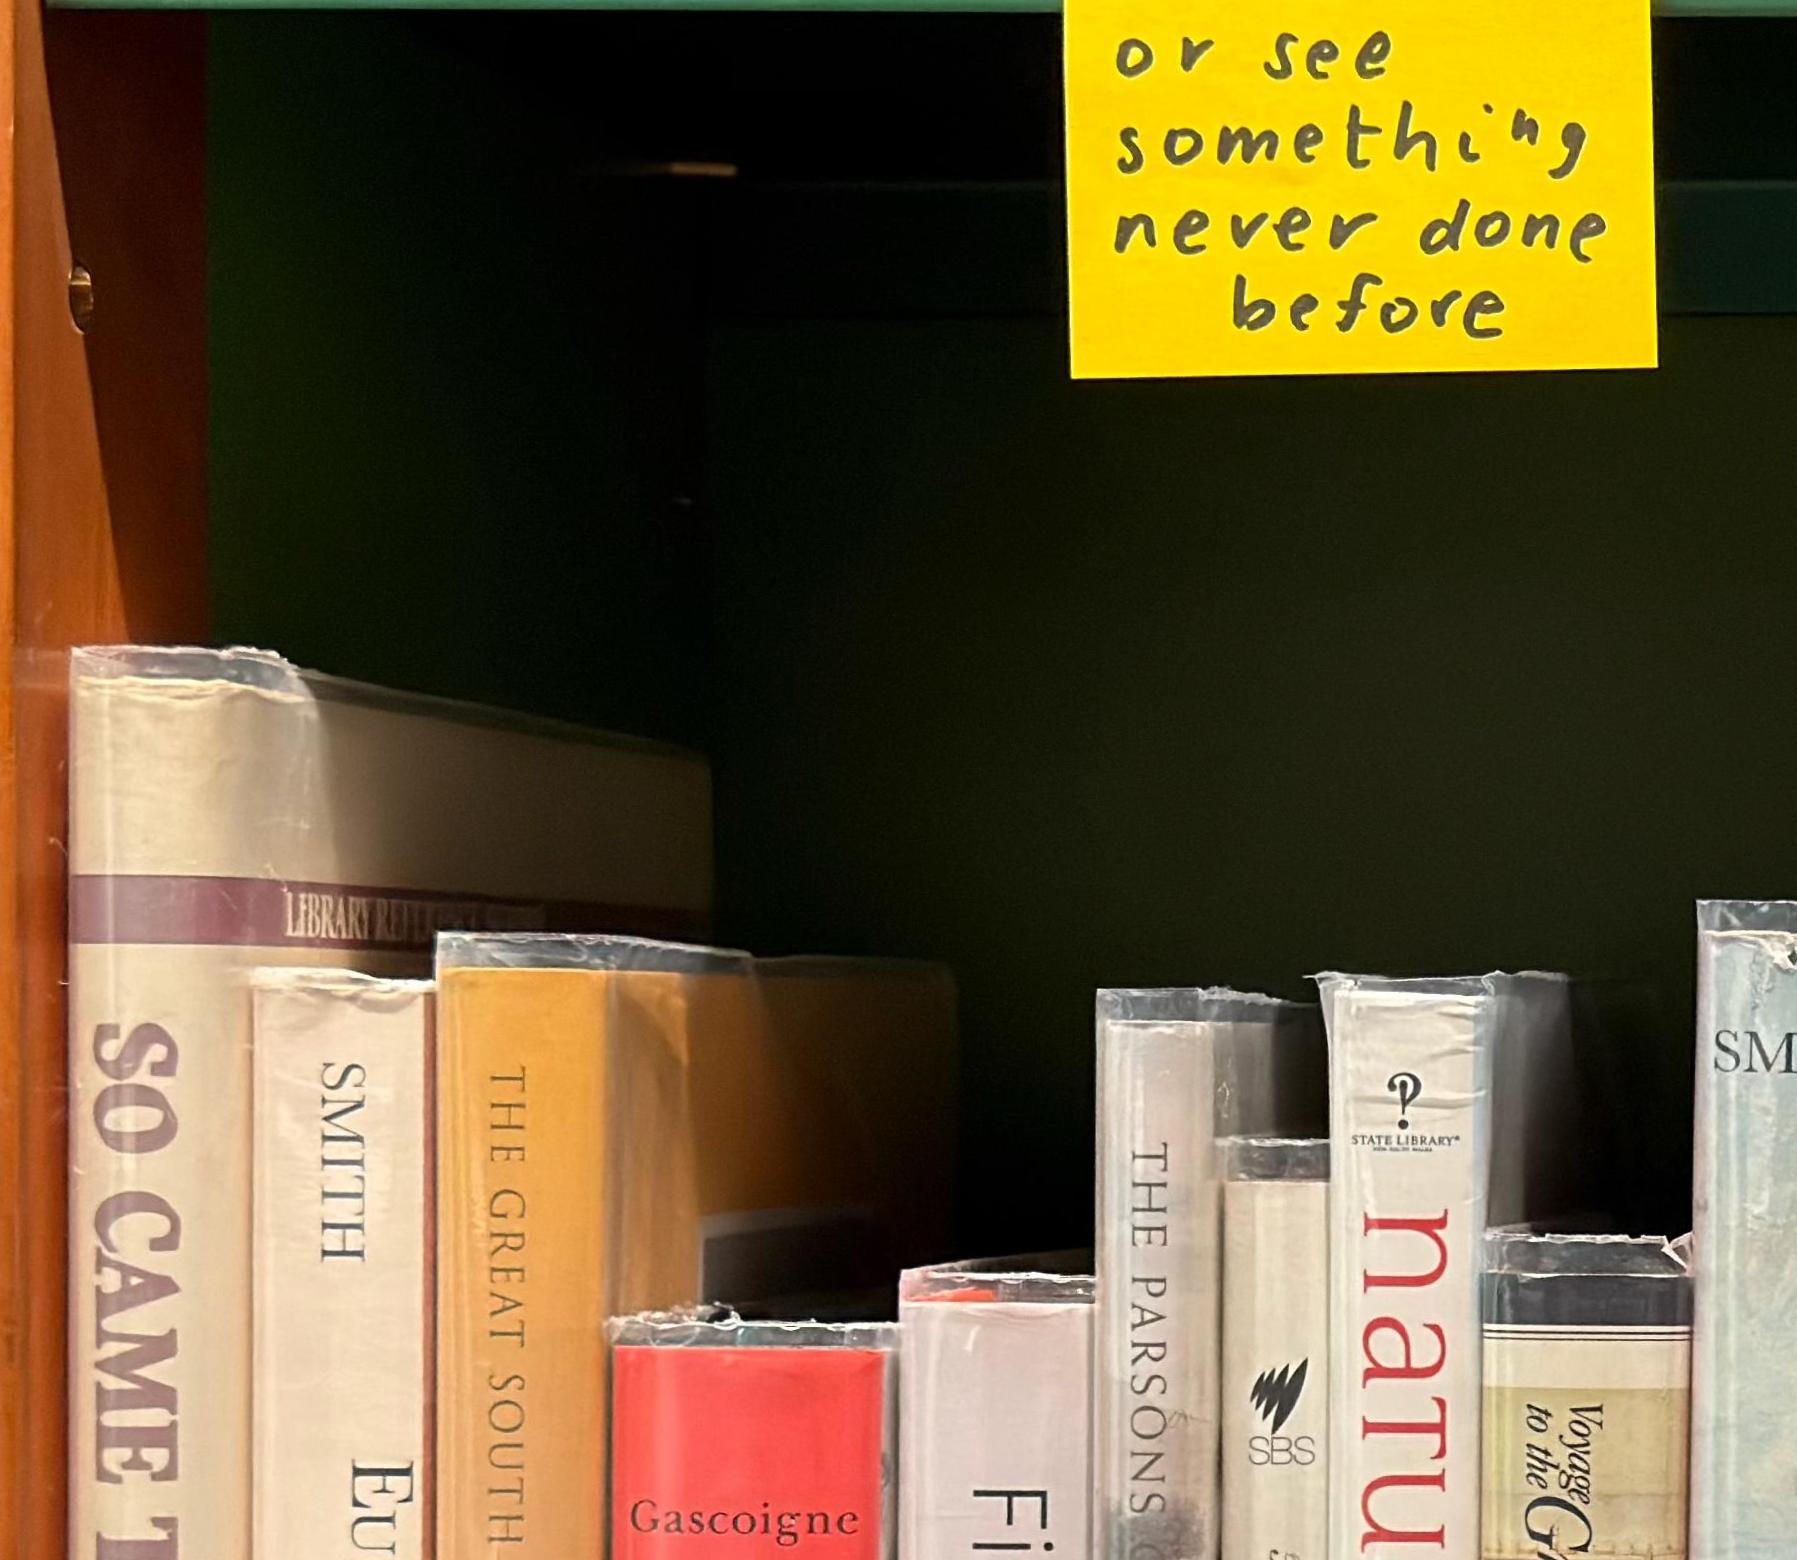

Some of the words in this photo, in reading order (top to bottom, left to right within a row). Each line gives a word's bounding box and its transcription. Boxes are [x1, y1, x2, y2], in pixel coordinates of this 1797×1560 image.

[1116, 36, 1214, 79] or
[1264, 31, 1391, 80] see
[1117, 101, 1587, 180] something
[1114, 205, 1378, 254] never
[1420, 198, 1607, 264] done
[1233, 273, 1505, 339] before
[93, 1021, 180, 1155] SO
[488, 1066, 526, 1163] THE
[319, 1061, 367, 1264] SMITH
[1130, 1142, 1169, 1248] THE
[487, 1189, 526, 1349] GREAT
[93, 1191, 181, 1484] CAME
[1128, 1276, 1169, 1516] PARSONS
[485, 1374, 526, 1544] SOUTH
[1248, 1435, 1316, 1466] SBS
[1525, 1443, 1560, 1490] the
[1558, 1403, 1604, 1505] Voyage
[629, 1499, 860, 1547] Gascoigne
